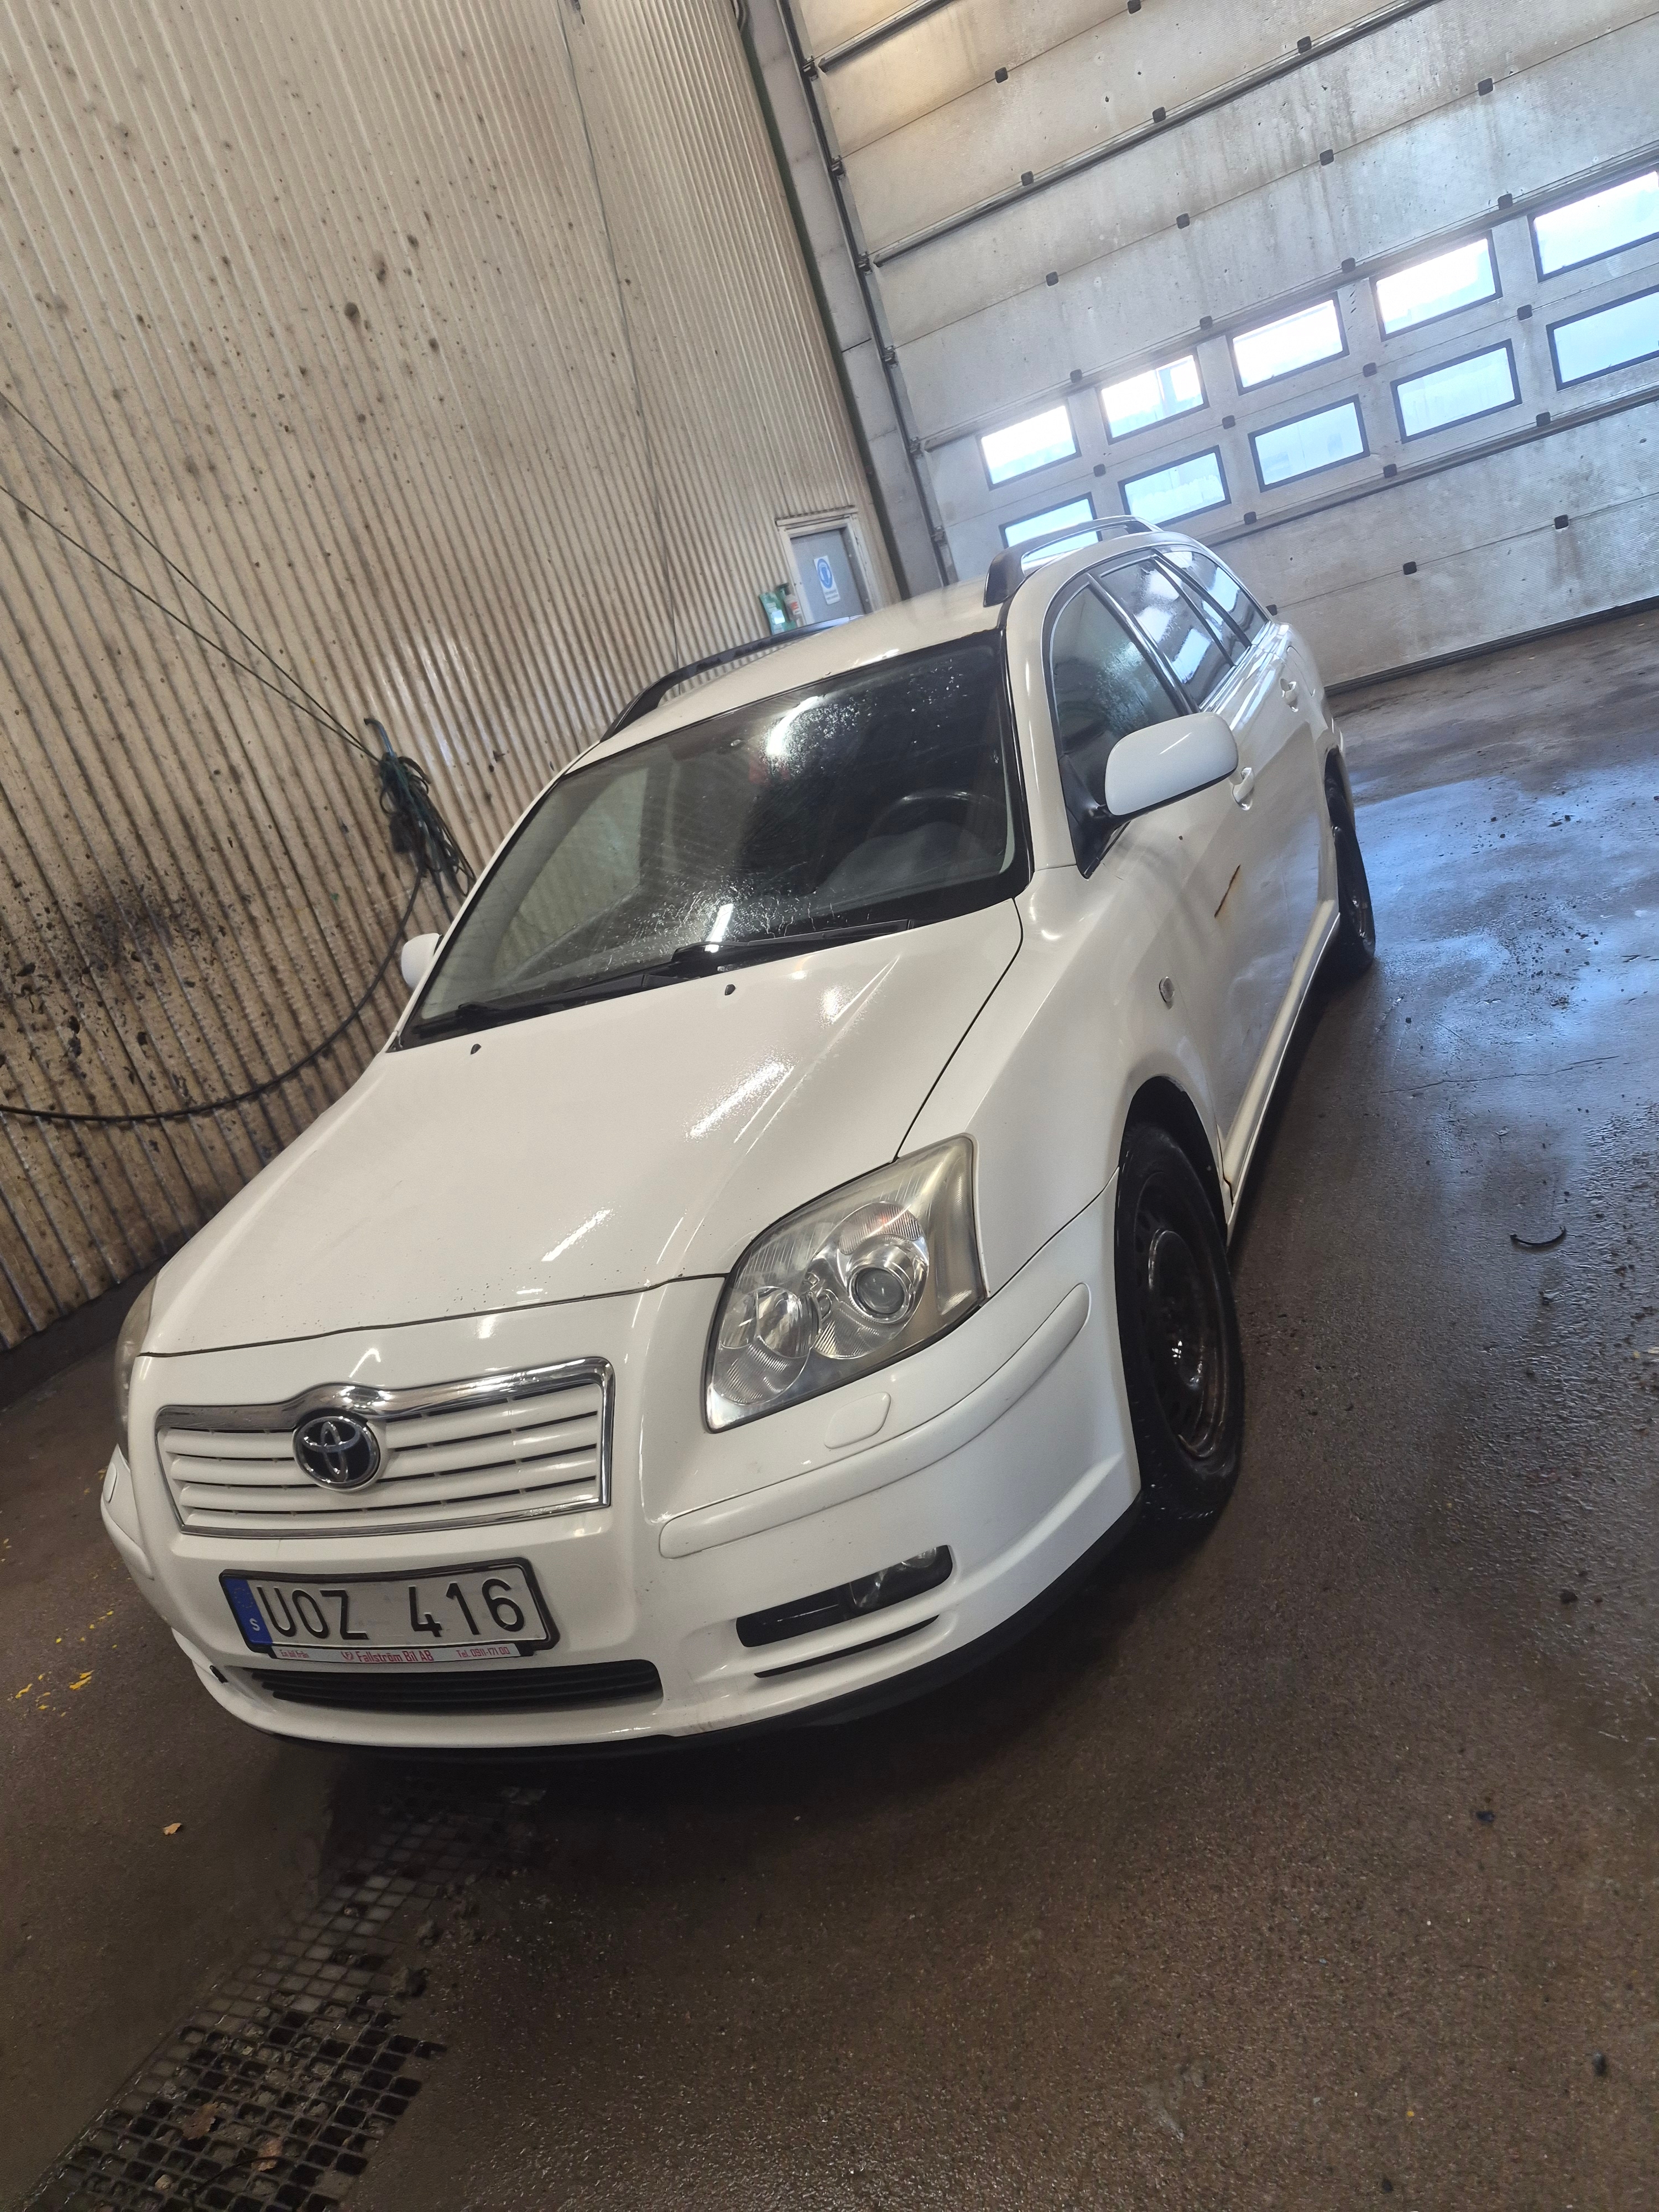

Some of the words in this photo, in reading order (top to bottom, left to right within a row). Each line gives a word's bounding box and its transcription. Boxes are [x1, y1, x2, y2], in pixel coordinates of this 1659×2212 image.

[256, 1585, 369, 1640] UOZ
[408, 1578, 525, 1638] 416
[249, 1618, 260, 1631] S
[356, 1651, 403, 1662] Fallström
[402, 1650, 418, 1662] Bil
[419, 1650, 434, 1661] AB
[456, 1650, 471, 1658] Tel.
